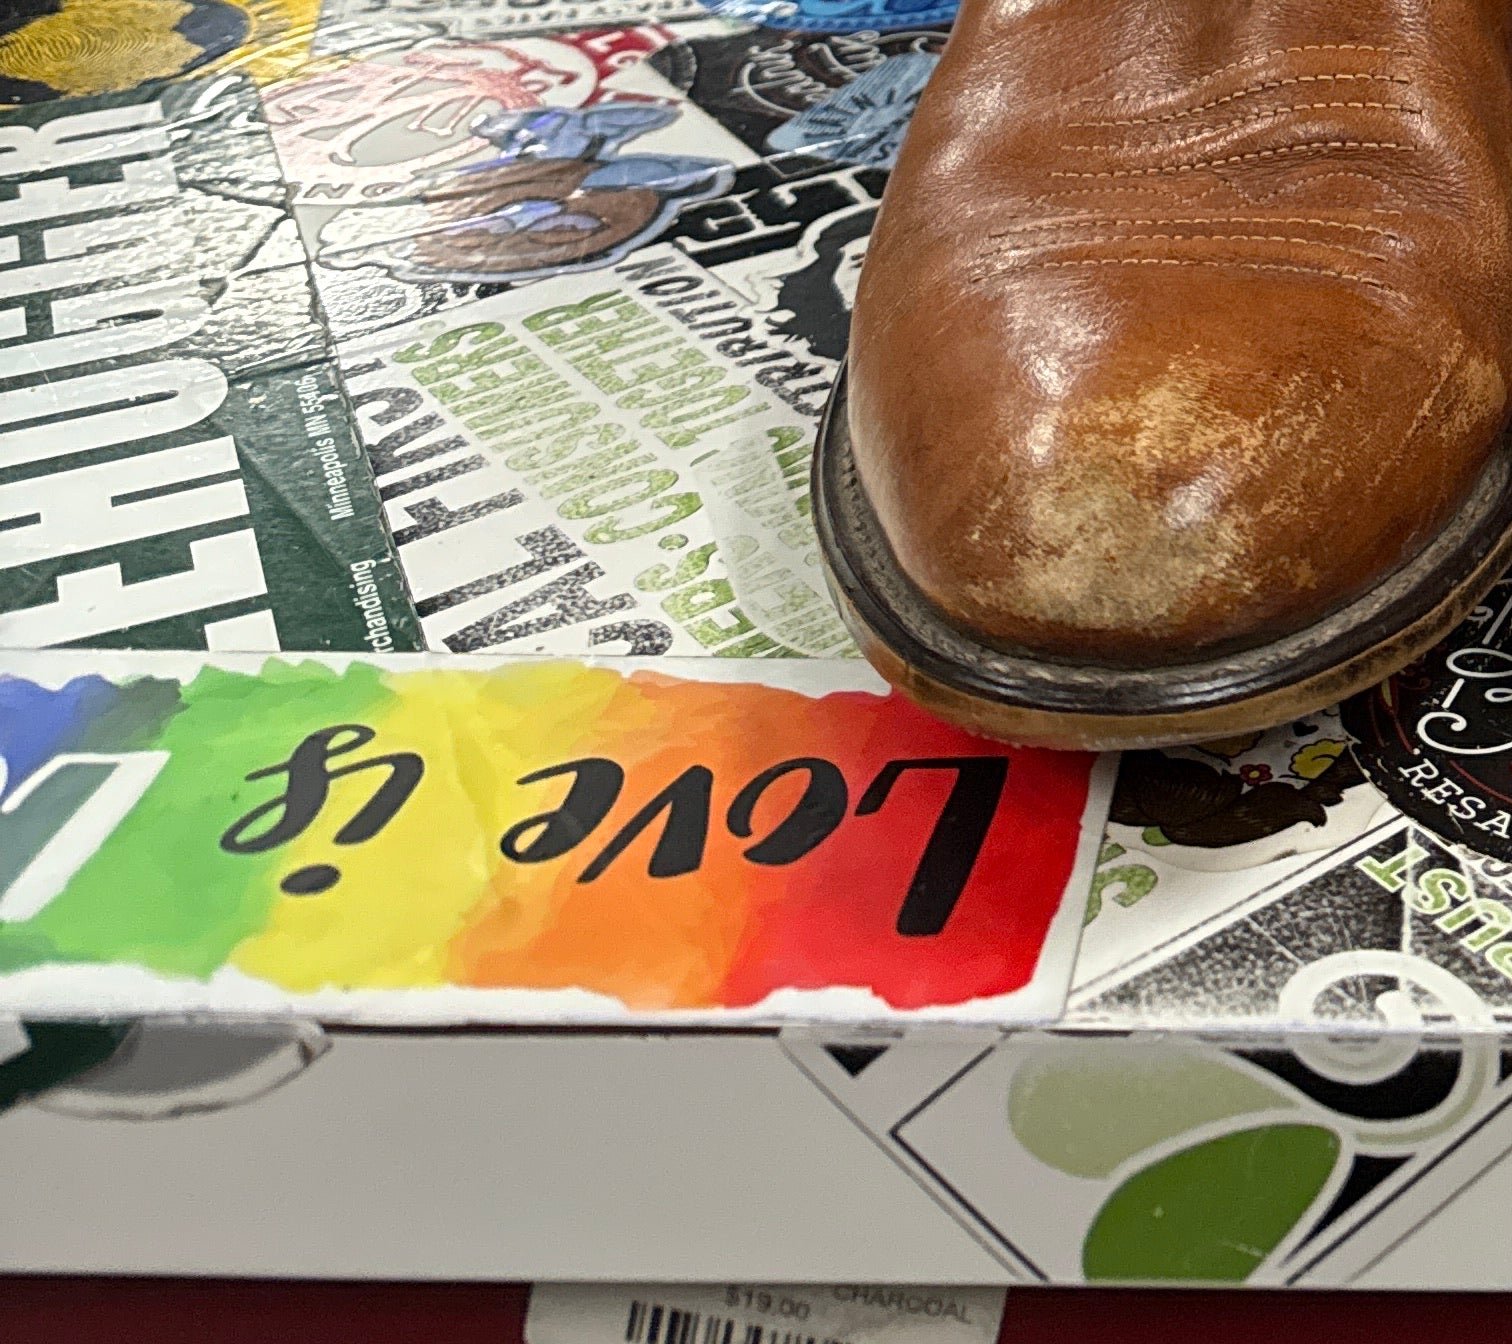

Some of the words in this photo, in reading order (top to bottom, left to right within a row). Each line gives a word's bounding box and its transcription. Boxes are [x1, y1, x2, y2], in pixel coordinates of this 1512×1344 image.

[305, 415, 331, 438] MN
[310, 437, 355, 521] Minneapolis
[220, 724, 426, 896] is
[499, 754, 1008, 937] Love
